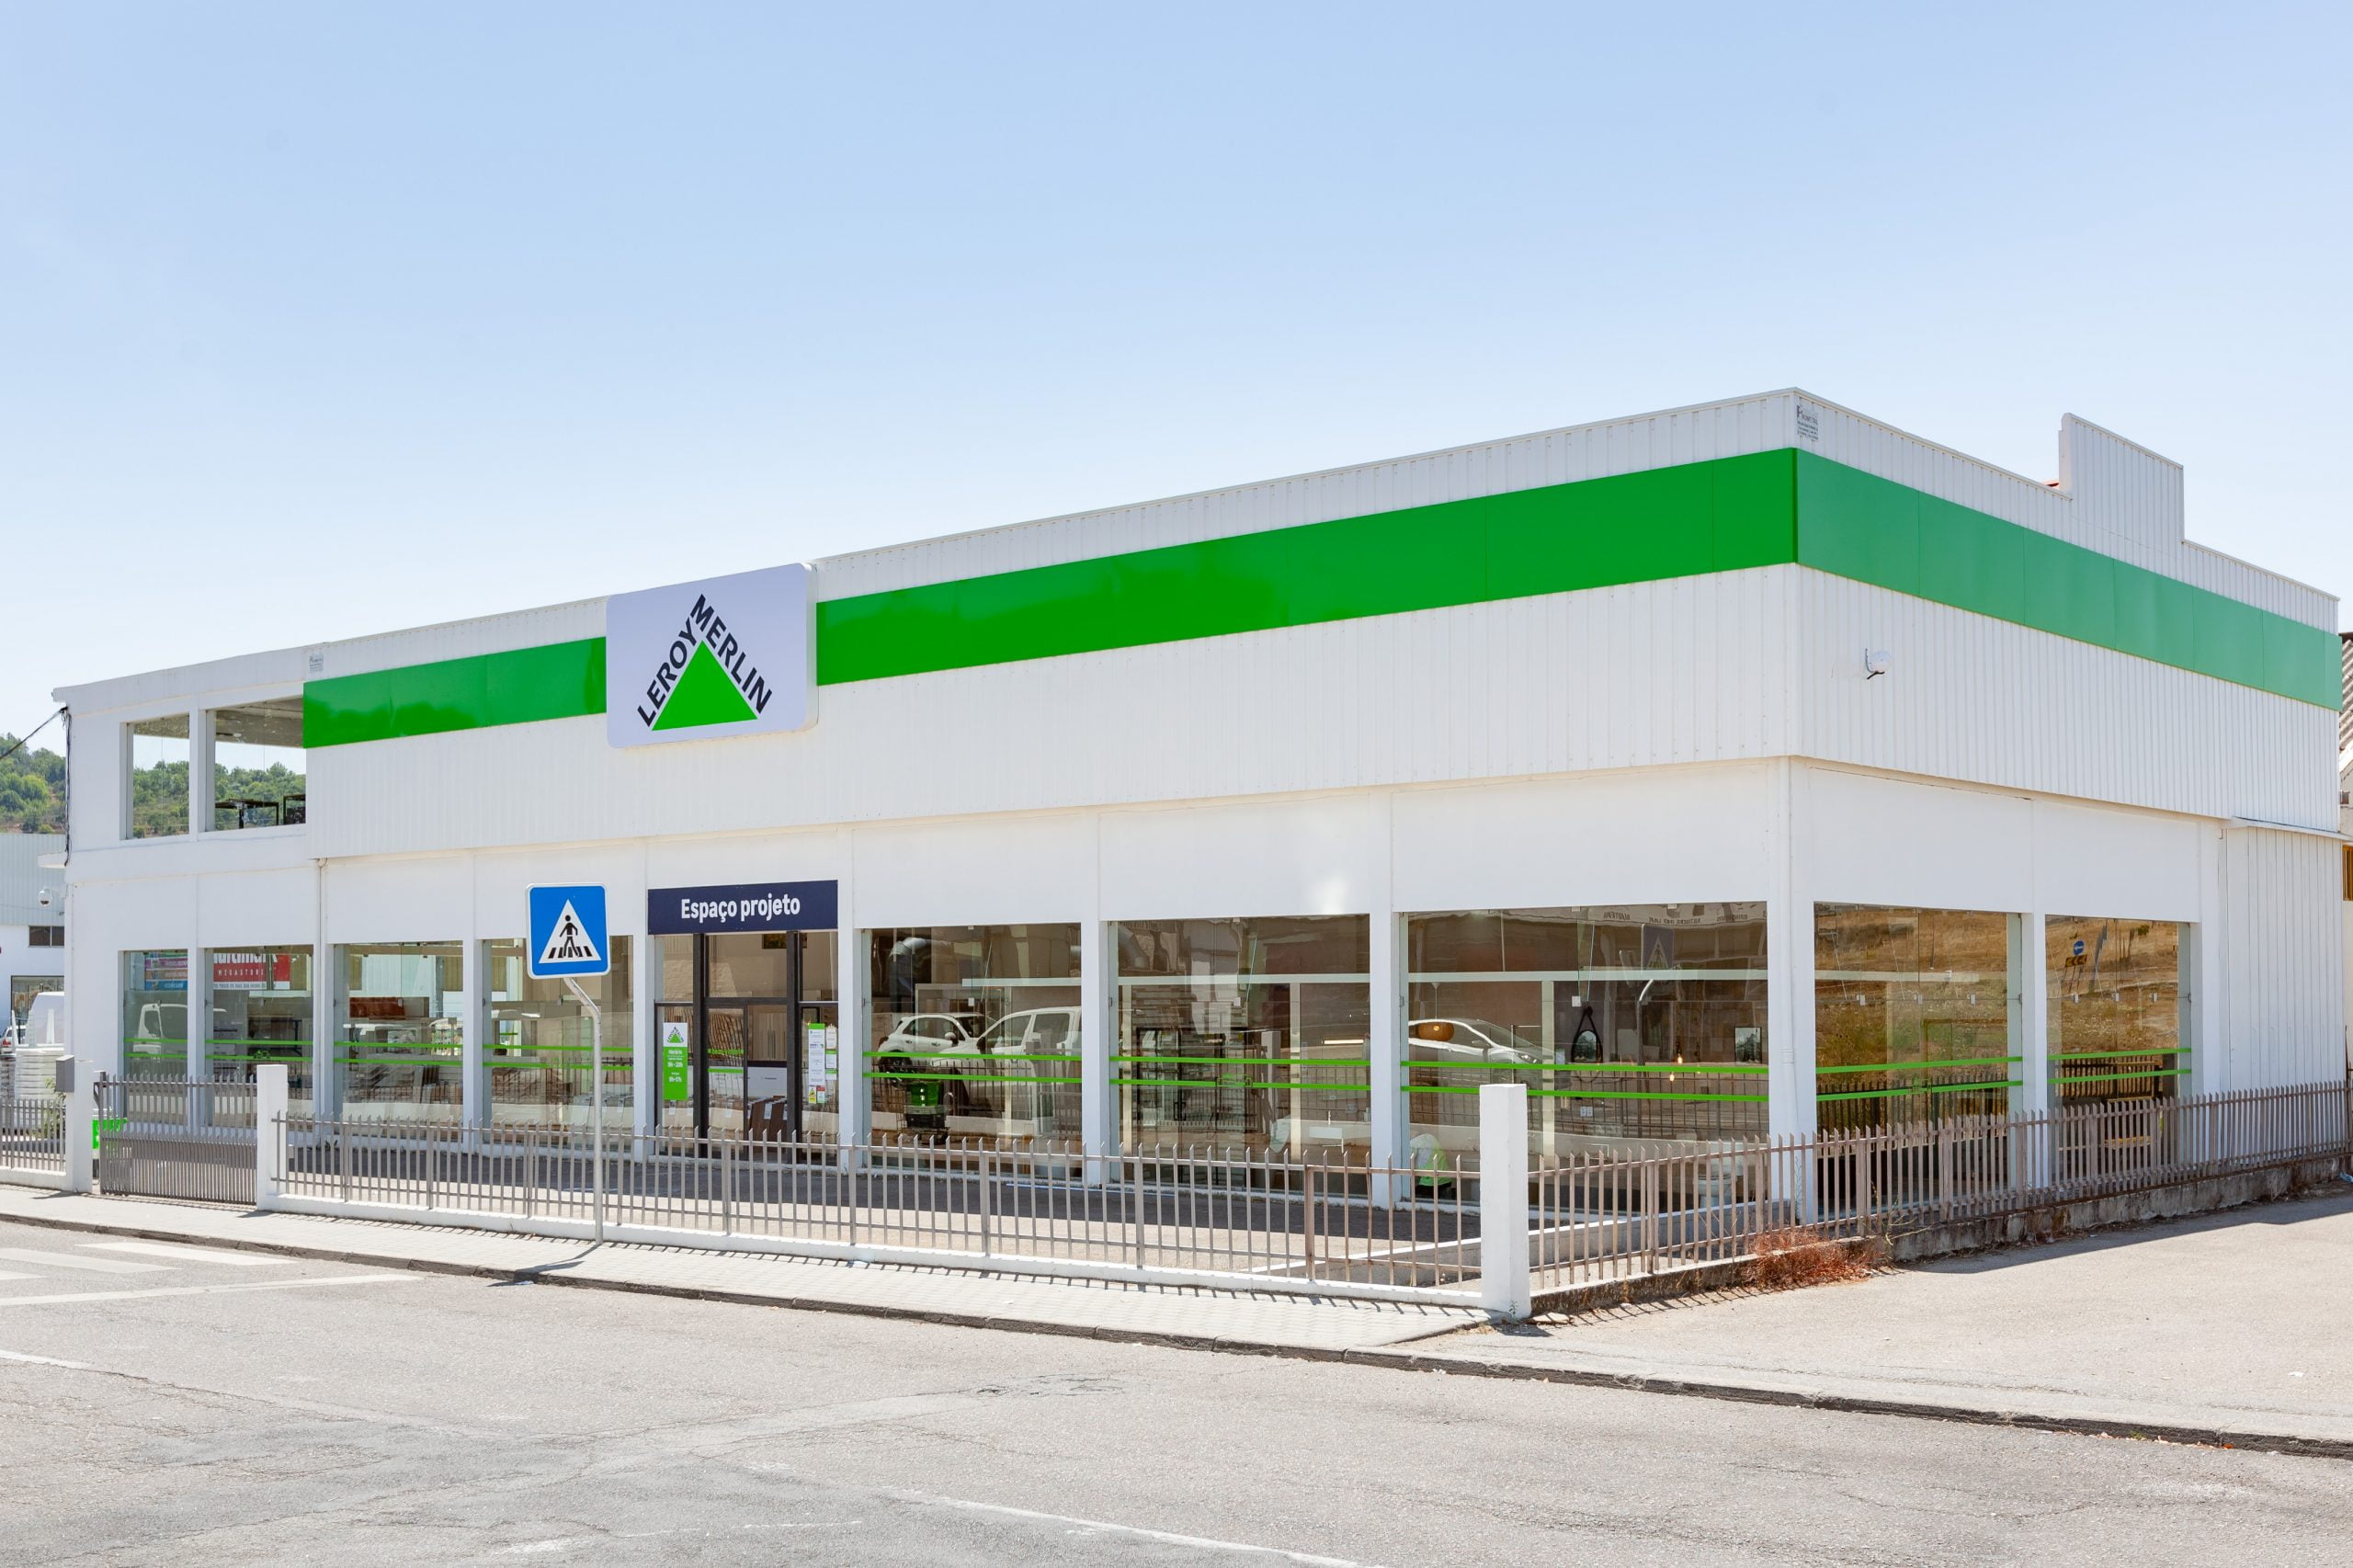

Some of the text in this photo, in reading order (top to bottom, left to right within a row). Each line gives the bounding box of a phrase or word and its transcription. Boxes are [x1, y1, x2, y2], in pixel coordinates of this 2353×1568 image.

[637, 593, 773, 727] LEROY MERLIN
[681, 892, 801, 924] Espaço projeto
